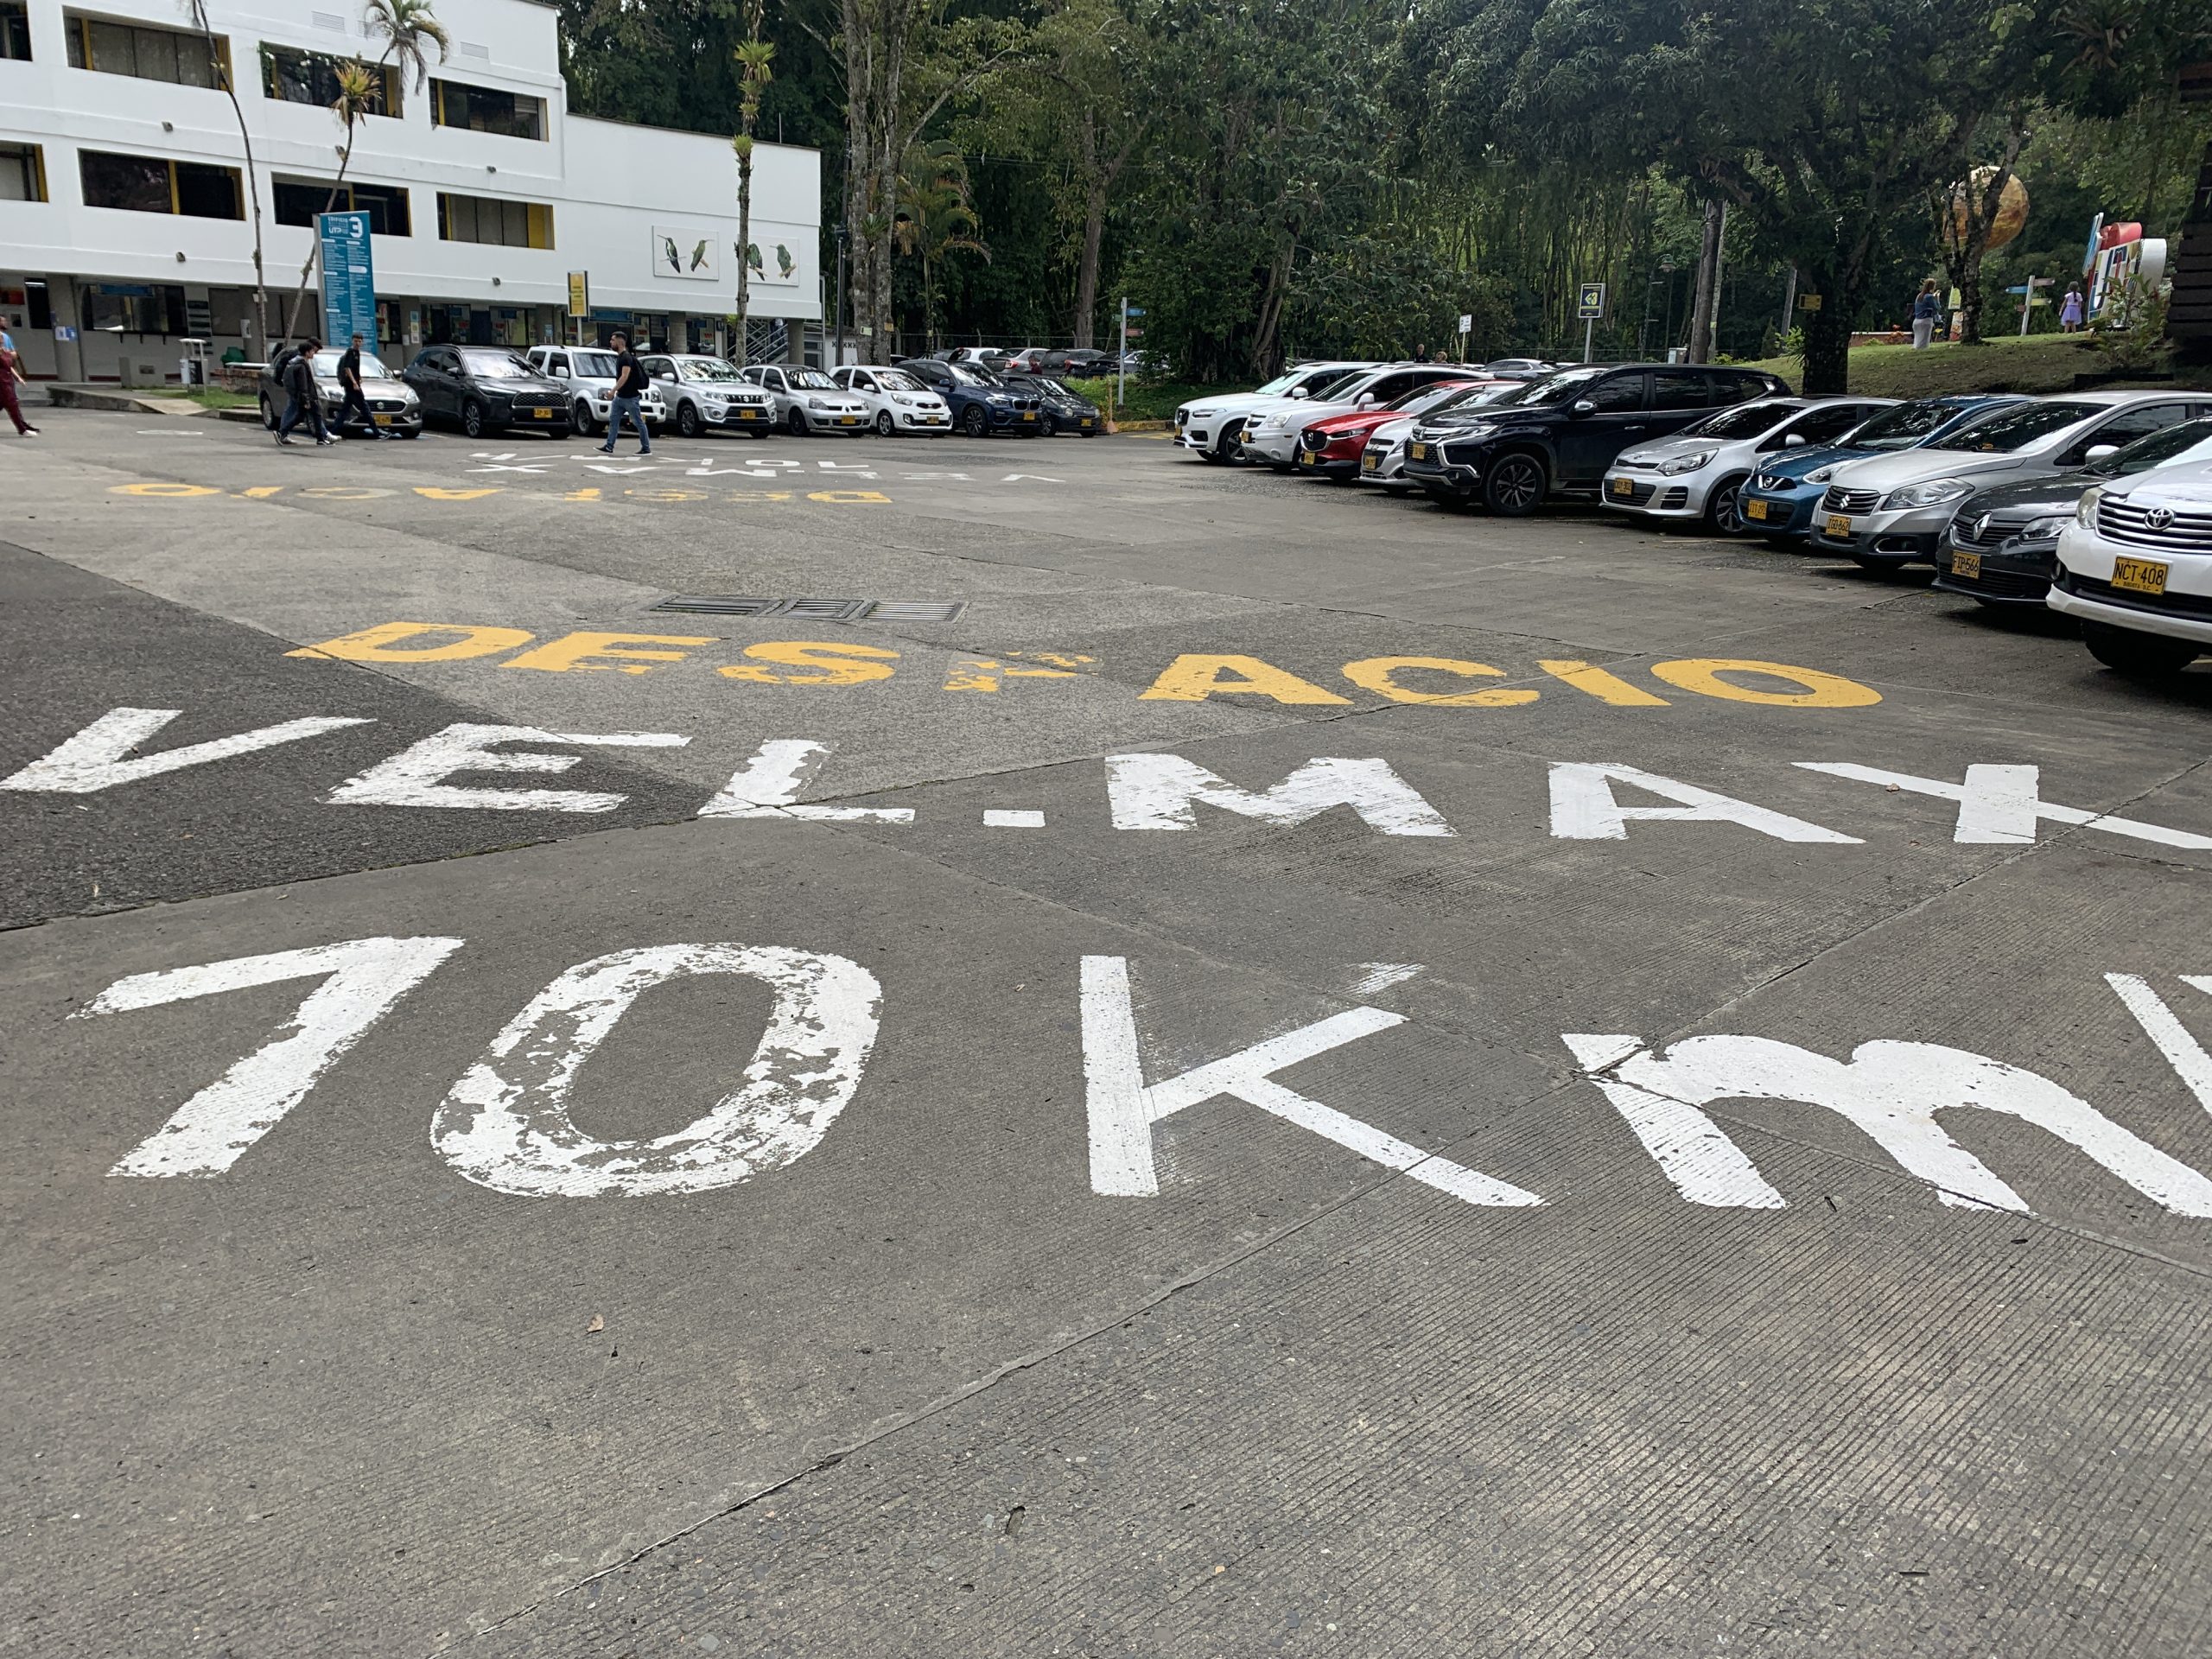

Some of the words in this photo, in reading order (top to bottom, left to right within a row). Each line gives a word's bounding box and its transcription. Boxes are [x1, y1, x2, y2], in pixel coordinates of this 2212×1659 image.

[348, 216, 363, 238] 3
[67, 937, 883, 1198] 10
[1079, 956, 2212, 1218] Km/
